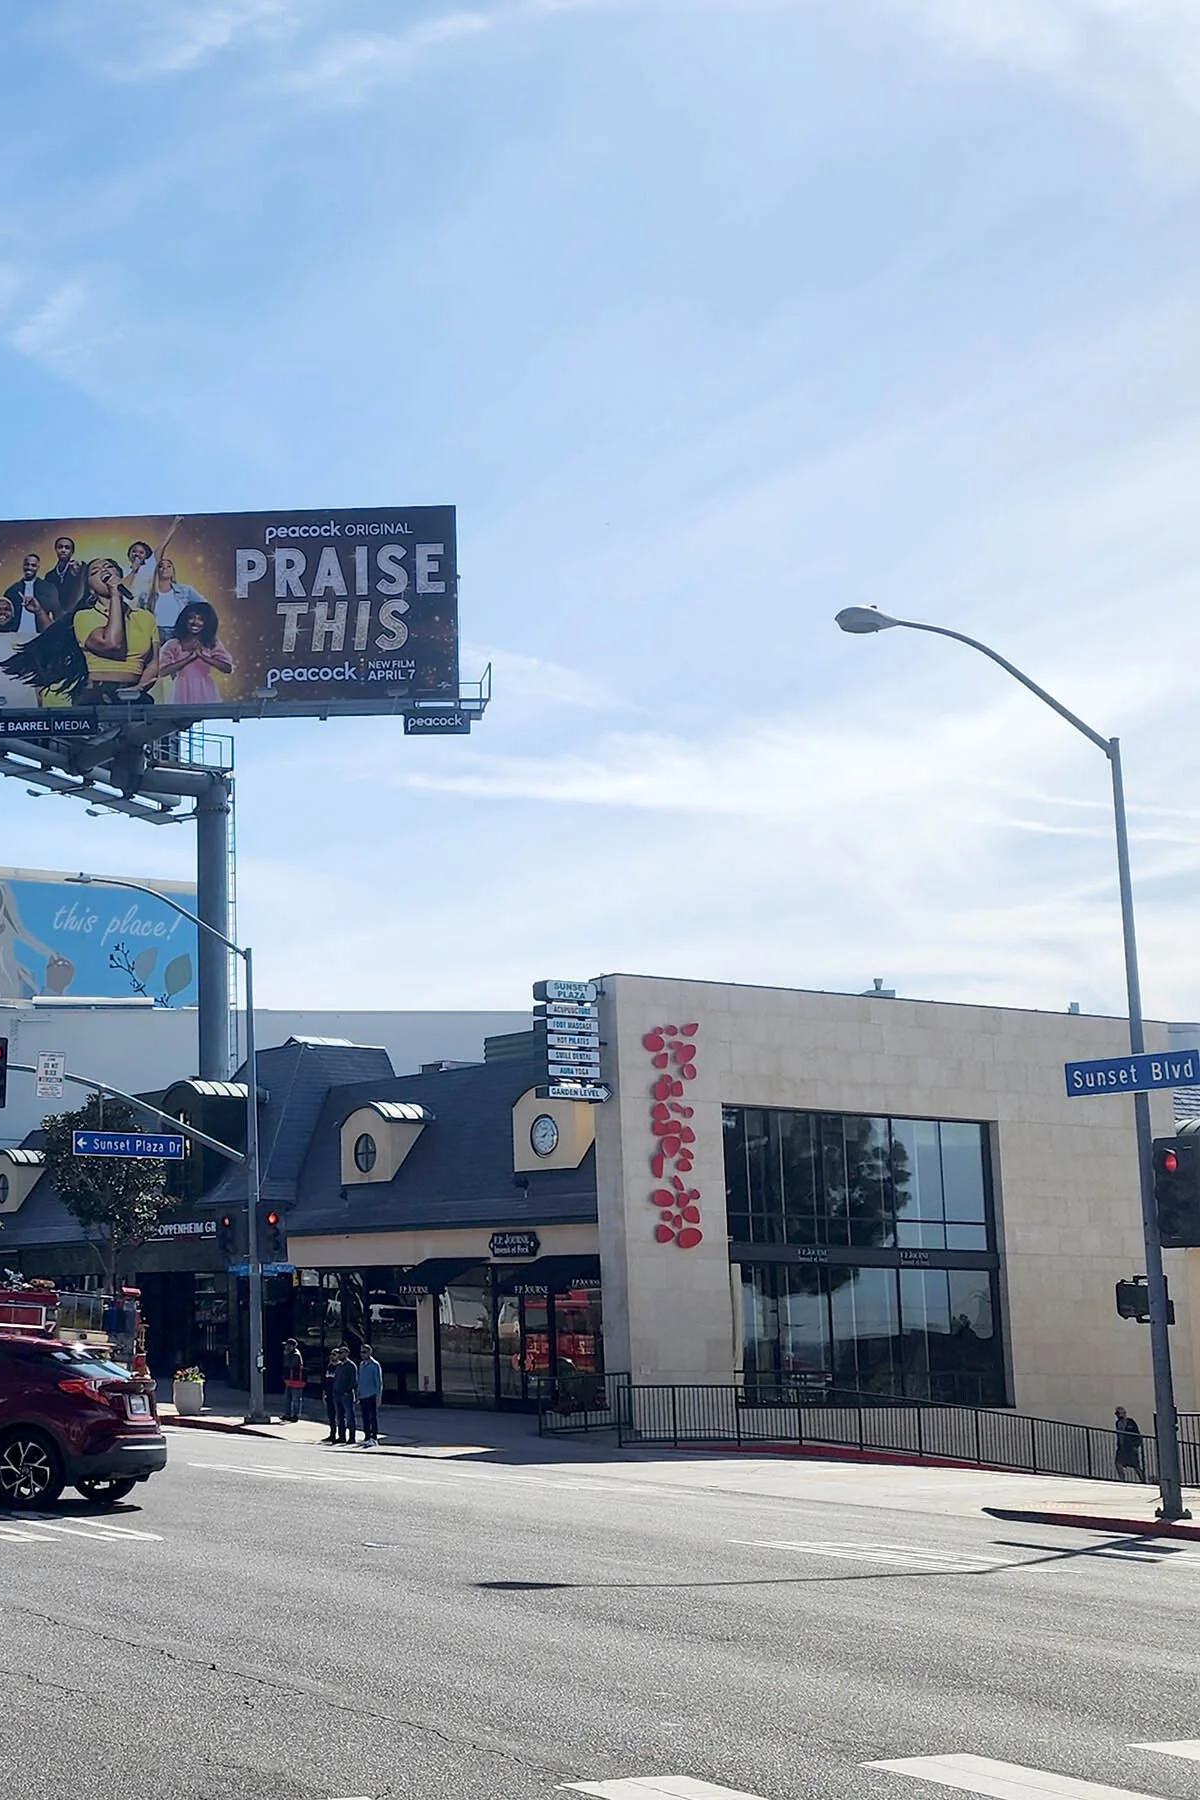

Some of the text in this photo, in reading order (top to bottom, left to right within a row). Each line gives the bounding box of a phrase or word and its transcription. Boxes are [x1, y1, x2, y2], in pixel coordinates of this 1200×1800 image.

[266, 520, 413, 544] peacock ORIGINAL
[236, 543, 446, 598] PRAISE
[276, 599, 410, 652] THIS
[368, 659, 415, 669] NEW FILM
[267, 662, 357, 688] peacock
[368, 669, 416, 681] APRIL 7
[8, 721, 50, 731] BARREL
[54, 720, 90, 730] MEDIA
[408, 715, 463, 731] peacock
[53, 902, 184, 947] this place!
[554, 982, 588, 991] SUNSET
[558, 990, 586, 999] PLAZA
[1073, 1058, 1194, 1089] Sunset Blvd
[551, 1087, 600, 1097] GARDEN LEVEL
[93, 1137, 182, 1153] Sunset Plaza Dr
[158, 1222, 204, 1236] OPPENHEIM
